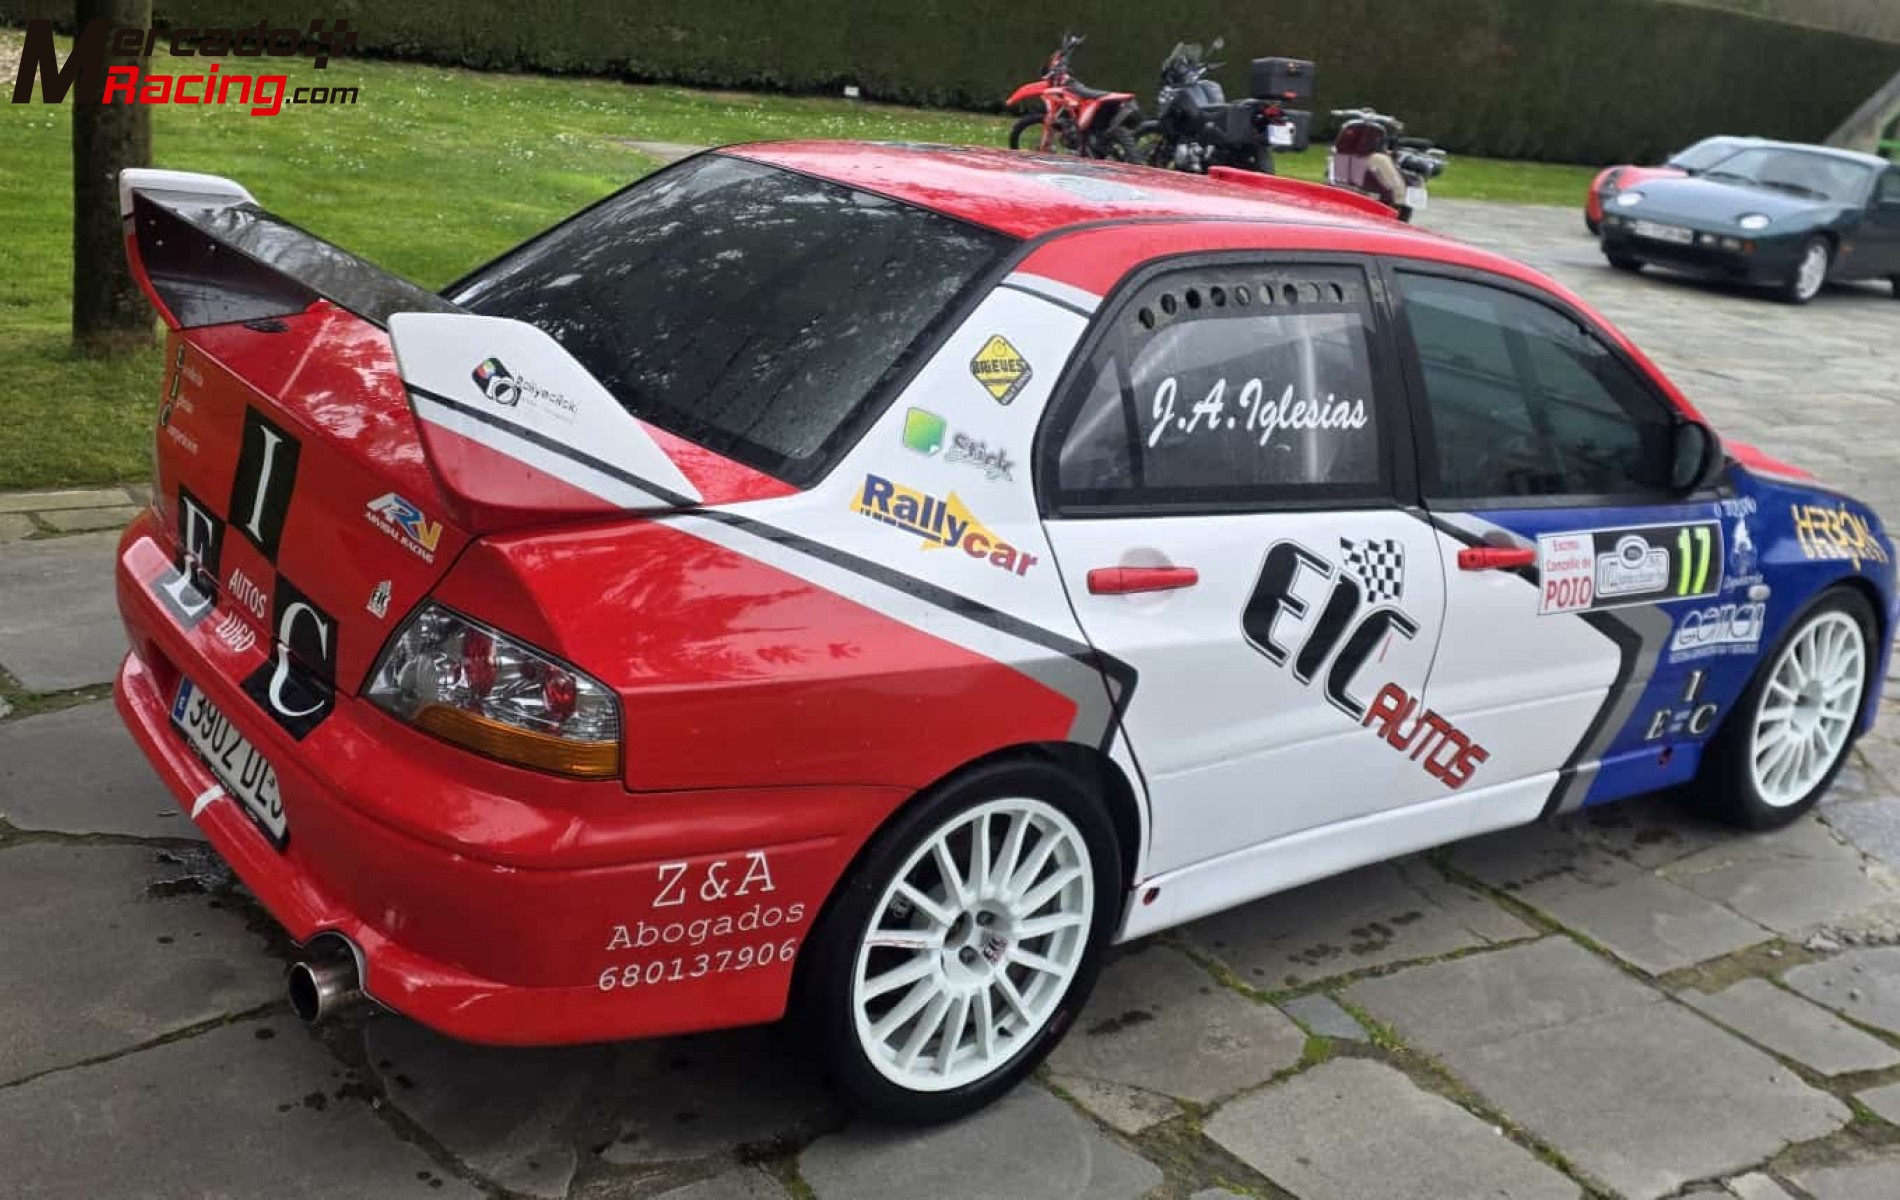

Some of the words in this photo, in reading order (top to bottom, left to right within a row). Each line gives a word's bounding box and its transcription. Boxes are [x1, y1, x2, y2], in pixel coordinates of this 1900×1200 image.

[862, 473, 1038, 577] Rallycar
[1677, 526, 1711, 596] 17
[228, 567, 268, 619] AUTOS
[1544, 576, 1593, 611] POIO
[215, 610, 256, 653] LUGO
[1362, 682, 1490, 789] AUTOS
[605, 902, 805, 950] Abogados
[599, 938, 797, 991] 680137906
